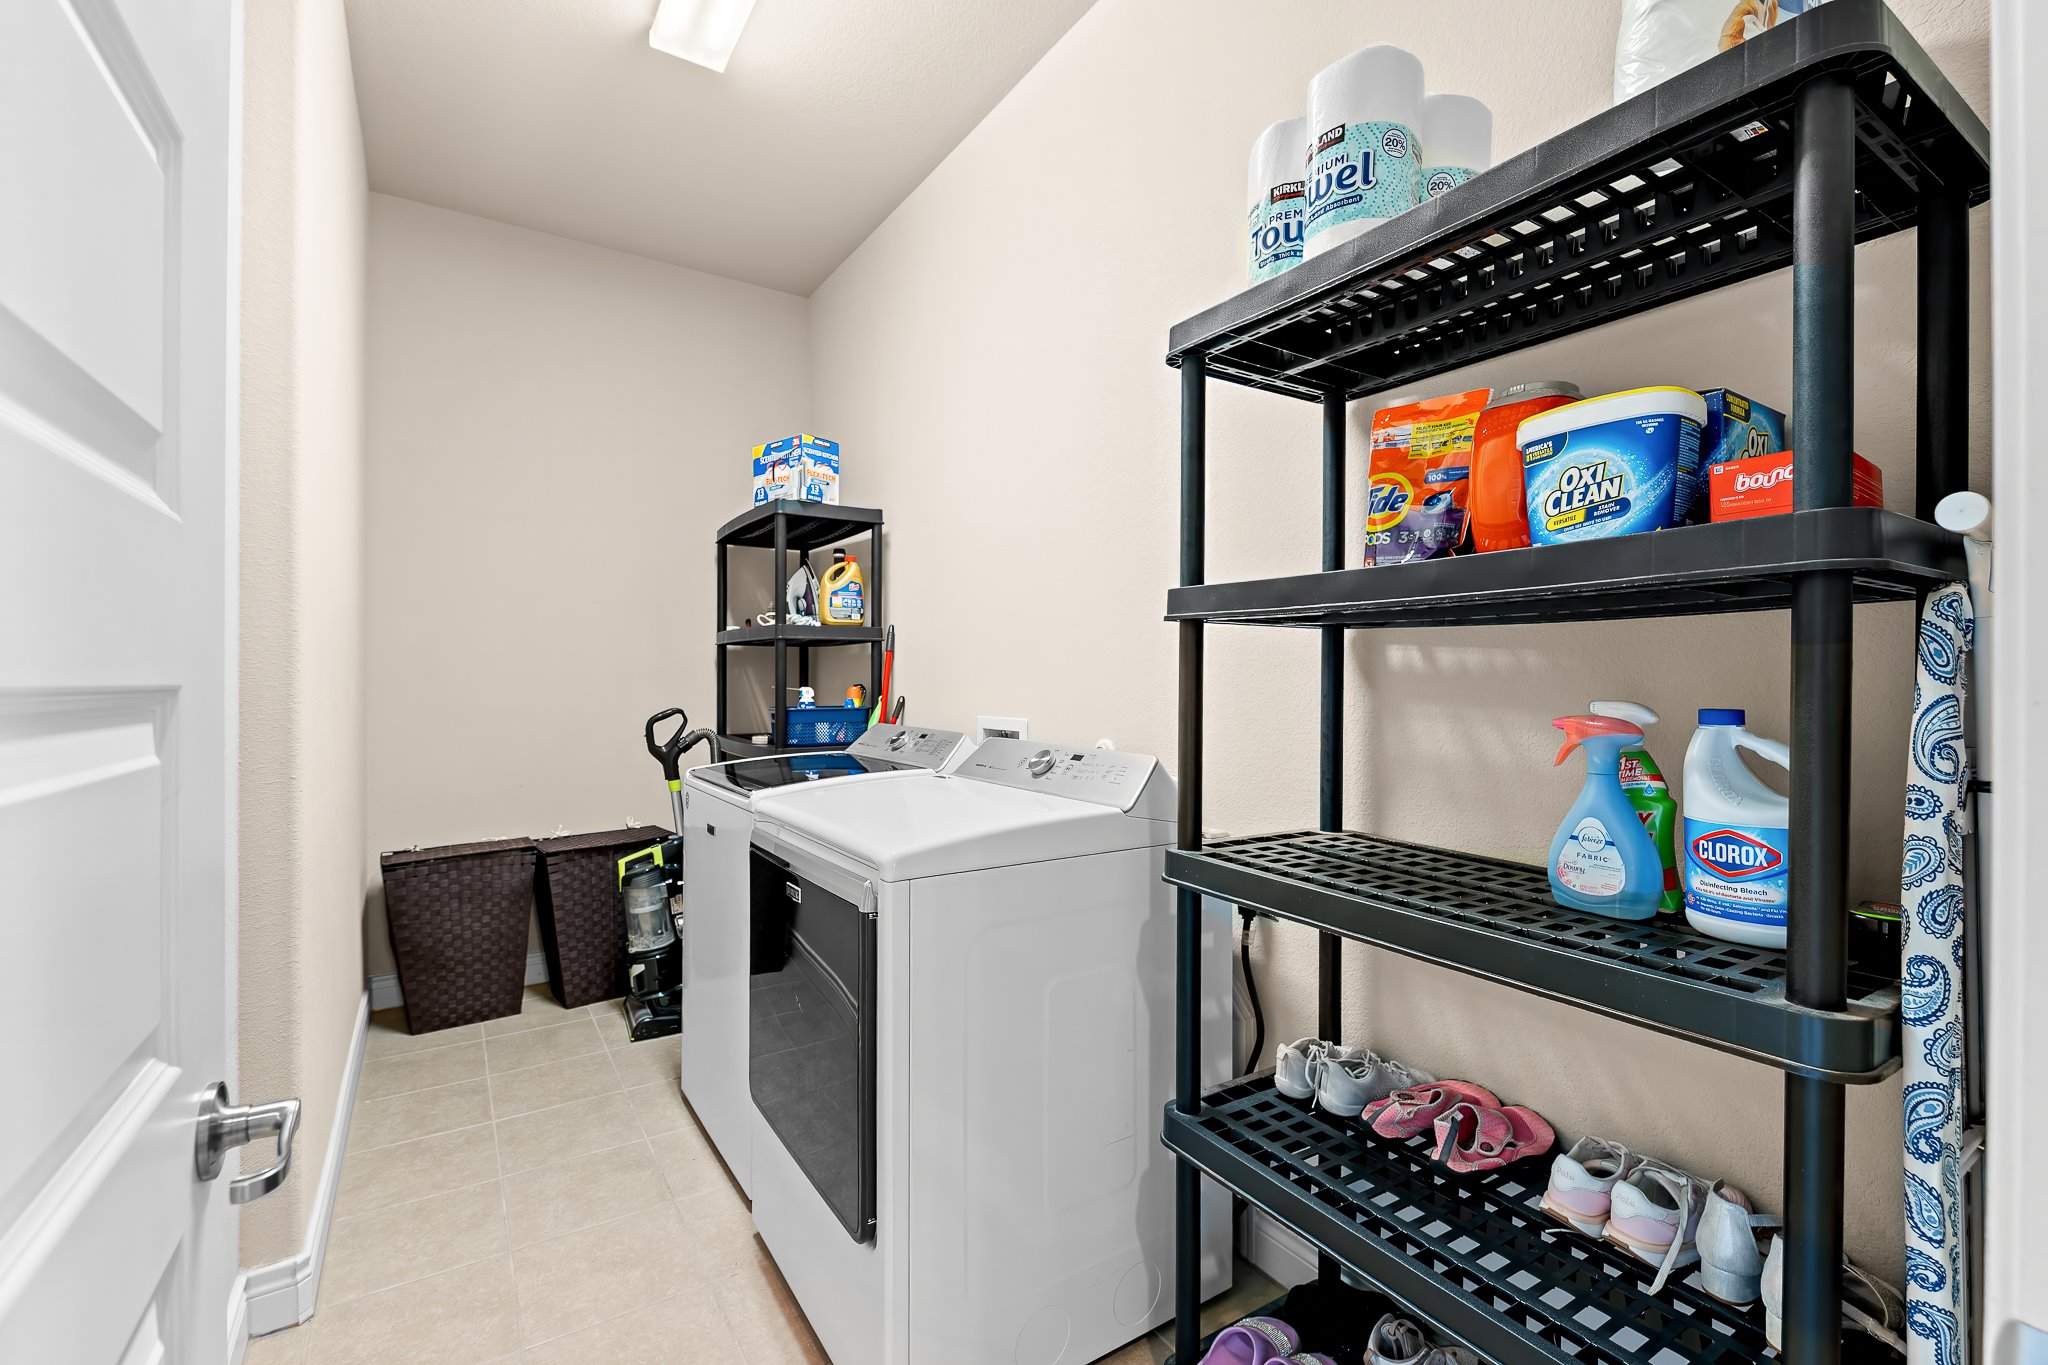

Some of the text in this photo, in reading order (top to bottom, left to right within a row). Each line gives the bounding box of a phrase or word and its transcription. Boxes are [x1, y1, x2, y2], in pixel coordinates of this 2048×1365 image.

[1385, 137, 1405, 151] 20%
[1273, 182, 1305, 198] KIRKL
[1430, 180, 1453, 191] 20%
[1325, 195, 1360, 211] Absorbent
[1748, 428, 1768, 457] OXI
[1560, 463, 1605, 493] OXI
[757, 488, 765, 497] 13
[811, 484, 820, 493] 13
[1545, 476, 1621, 517] CLEAN
[1593, 506, 1620, 517] REMOVER
[1598, 502, 1615, 511] STAIN
[1553, 514, 1577, 526] VERSATILE
[1576, 851, 1608, 863] FABRIC
[1699, 839, 1768, 867] CLOROX
[1563, 862, 1586, 875] Downy
[1700, 880, 1768, 896] Disinfecting Bleach
